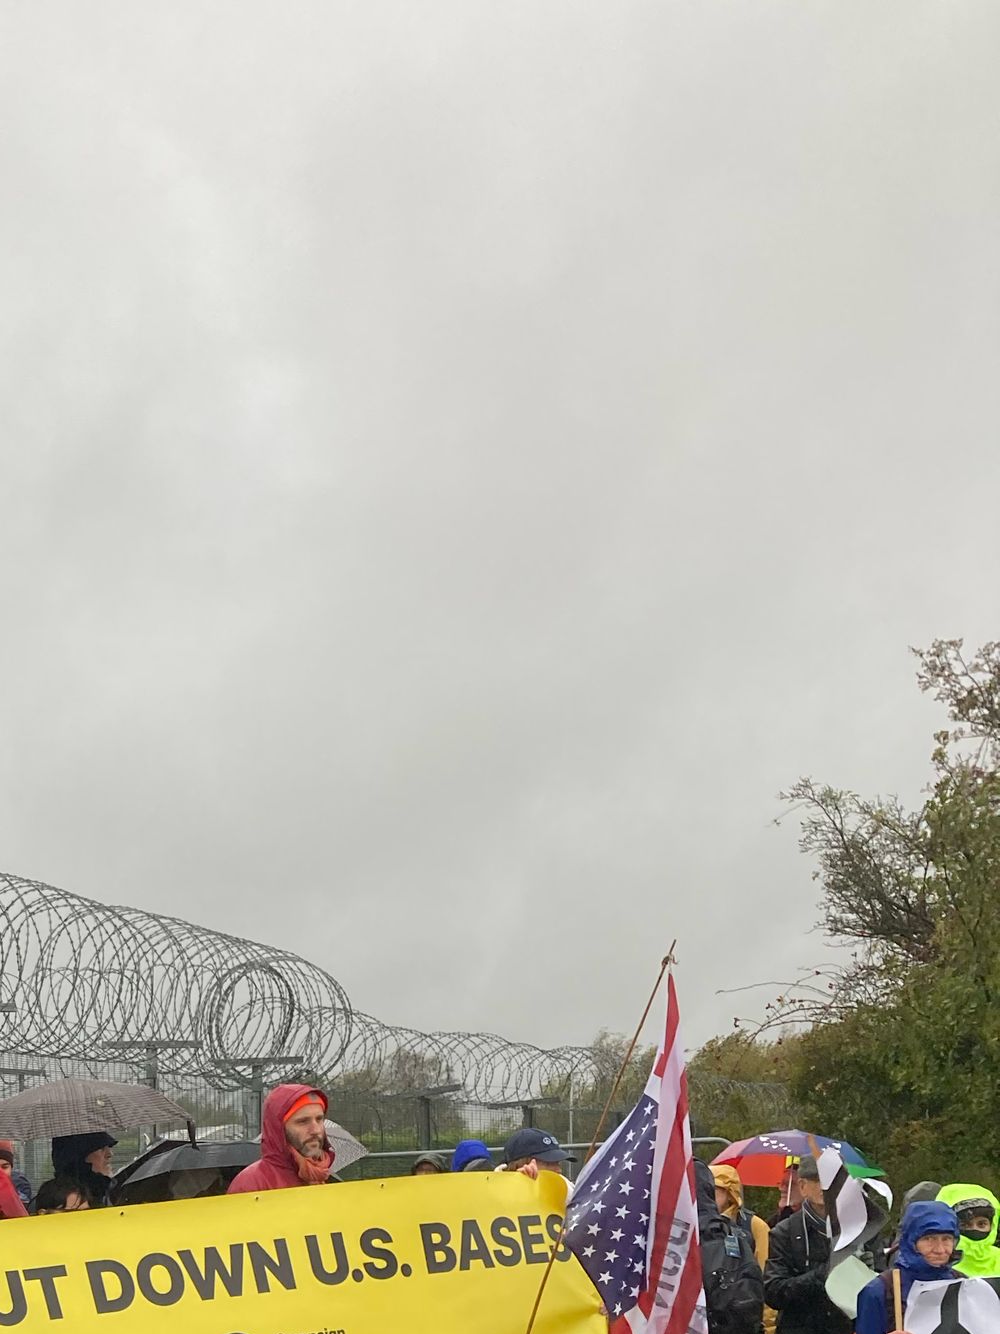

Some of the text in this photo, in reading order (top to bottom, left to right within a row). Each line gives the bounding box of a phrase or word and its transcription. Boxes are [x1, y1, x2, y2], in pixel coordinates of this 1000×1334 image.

[85, 1237, 297, 1315] DOWN
[304, 1226, 412, 1287] U.S.
[419, 1213, 572, 1275] BASES
